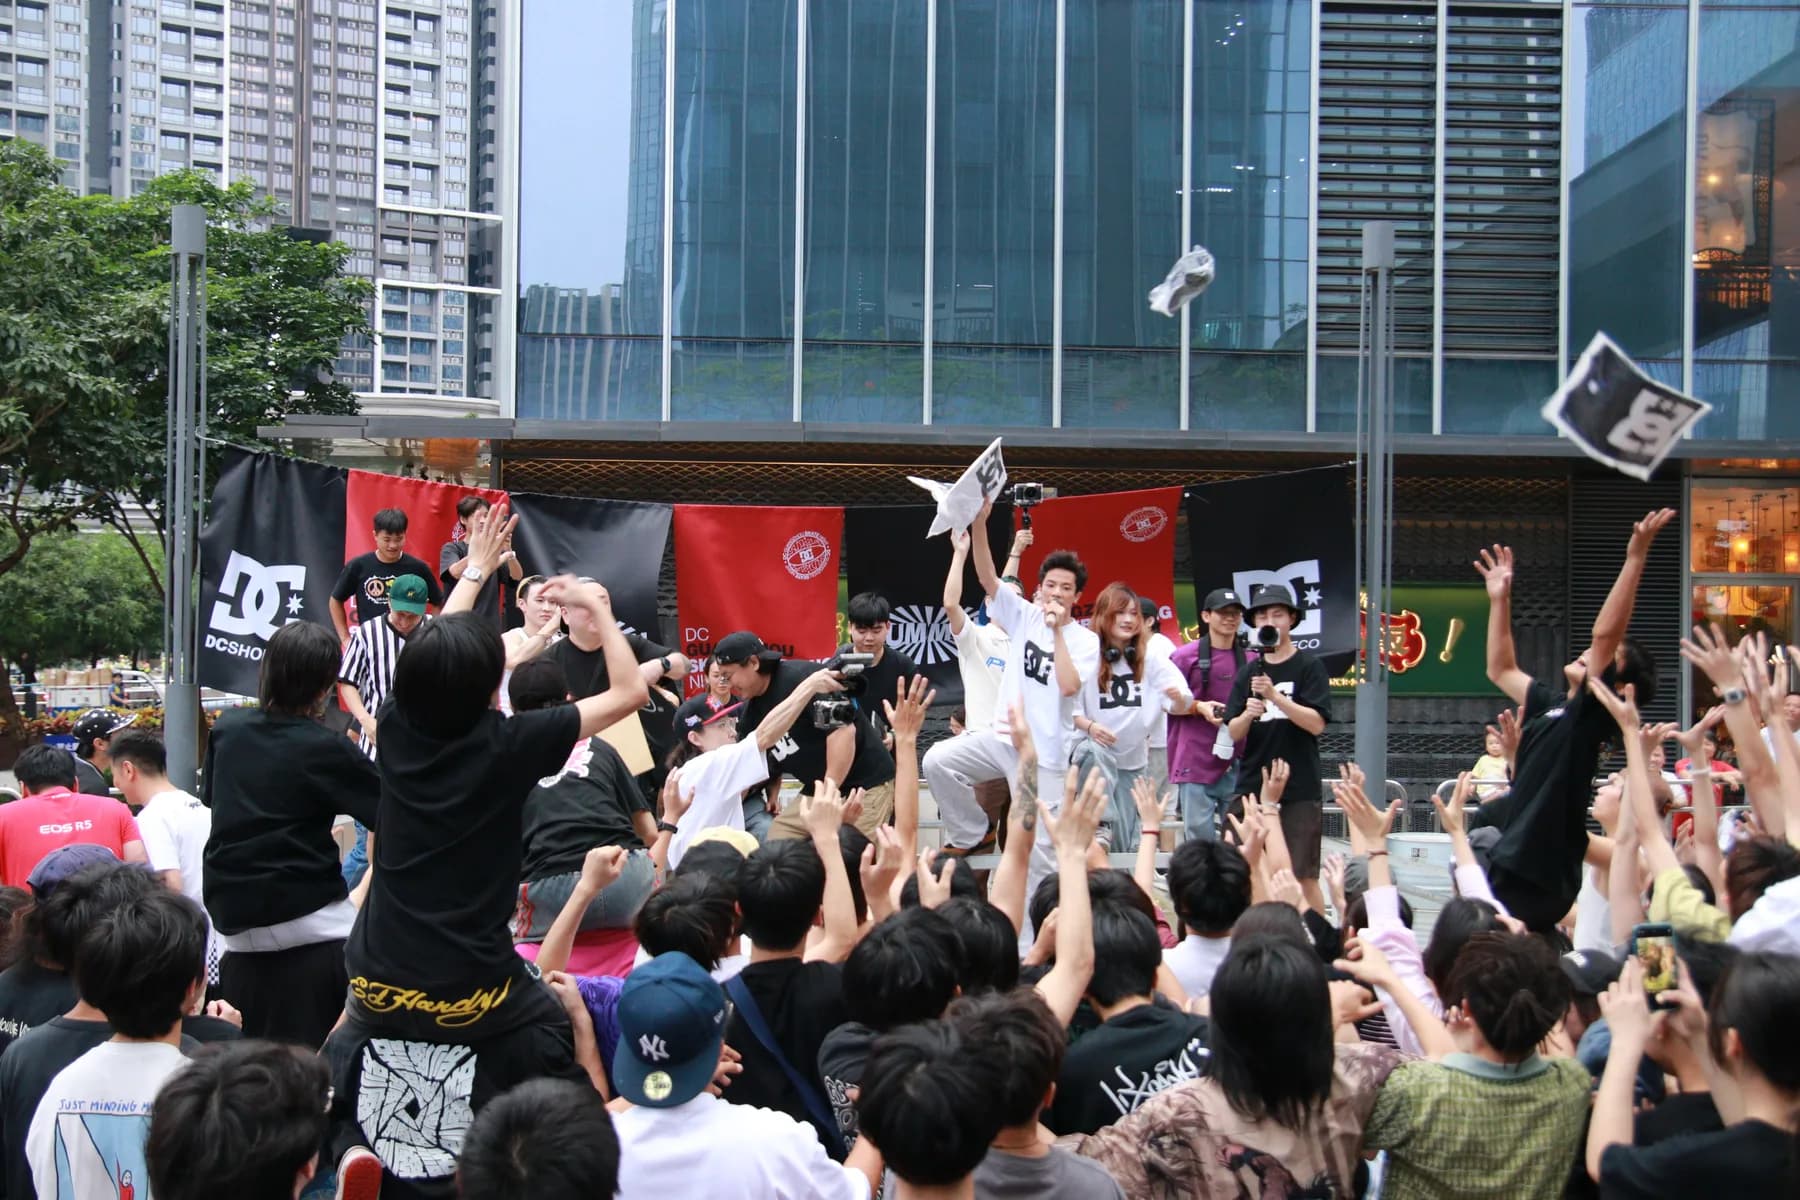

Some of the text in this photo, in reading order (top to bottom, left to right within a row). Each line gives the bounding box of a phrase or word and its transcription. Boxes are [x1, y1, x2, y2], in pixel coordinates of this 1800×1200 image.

[685, 627, 710, 642] DC
[204, 634, 266, 661] DCSHO
[39, 819, 93, 834] EOS R5
[59, 1099, 85, 1110] JUST
